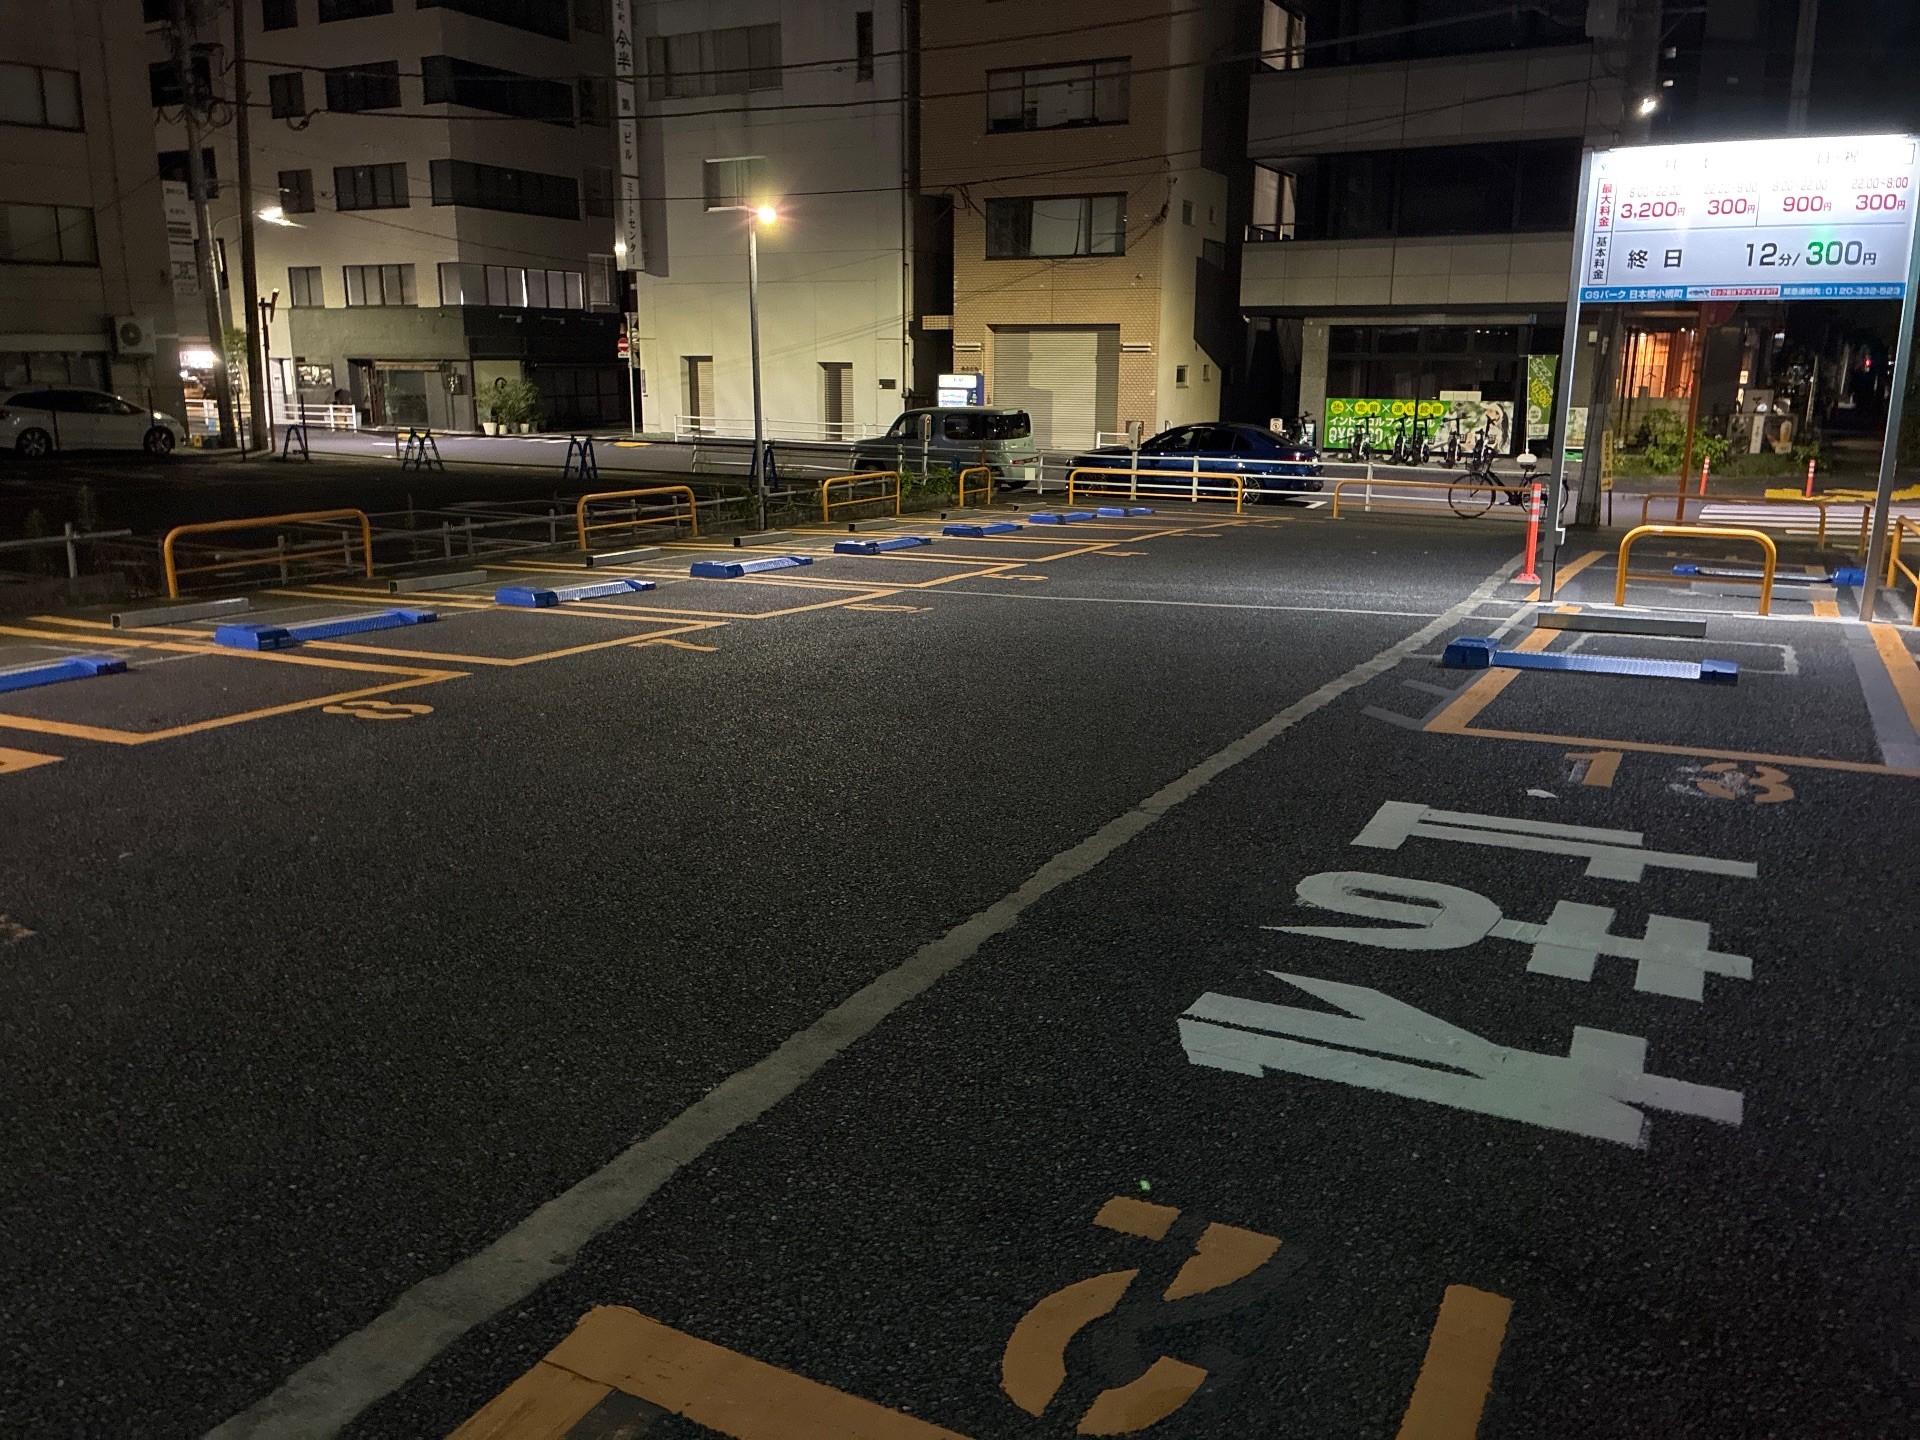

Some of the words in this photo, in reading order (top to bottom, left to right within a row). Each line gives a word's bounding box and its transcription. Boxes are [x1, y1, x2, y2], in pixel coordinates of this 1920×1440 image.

[626, 181, 637, 266] ミートセンター
[1598, 183, 1613, 228] 最大料金
[1620, 201, 1686, 219] 3,200円
[1707, 198, 1756, 216] 300円
[1782, 195, 1832, 213] 900円
[1855, 193, 1906, 211] 300円
[1592, 236, 1608, 280] 基本料金
[1585, 290, 1627, 300] GSパーク
[321, 699, 436, 720] 8
[1178, 799, 1759, 1151] 止まれ
